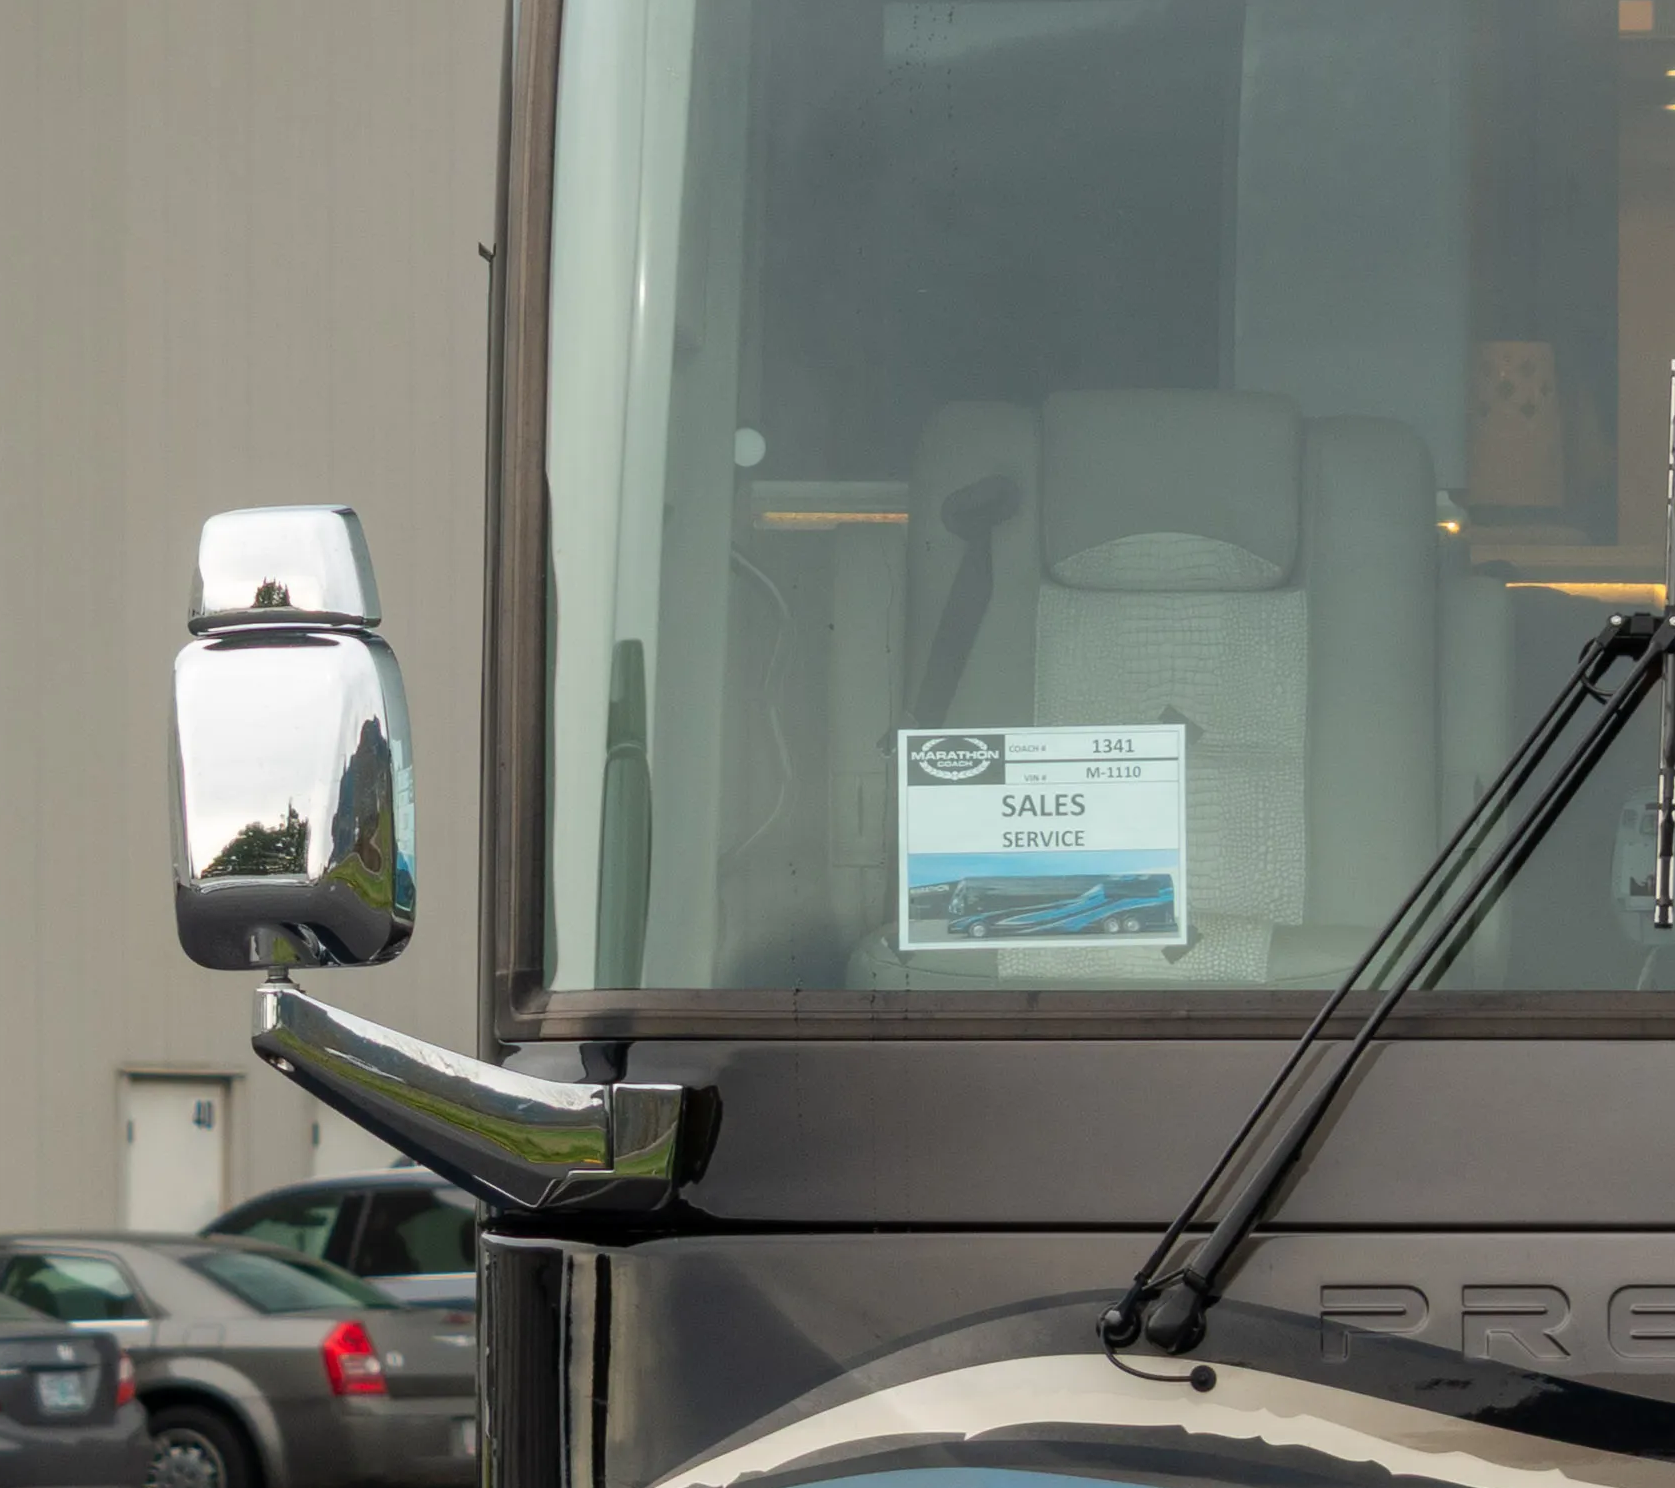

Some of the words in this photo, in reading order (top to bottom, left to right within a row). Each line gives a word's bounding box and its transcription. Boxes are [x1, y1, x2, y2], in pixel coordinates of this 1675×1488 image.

[1092, 739, 1135, 753] 1341
[911, 750, 999, 761] MARATHON
[937, 759, 973, 768] COACH
[1086, 766, 1141, 778] M-1110
[1001, 793, 1086, 818] SALES
[1002, 830, 1085, 848] SERVICE
